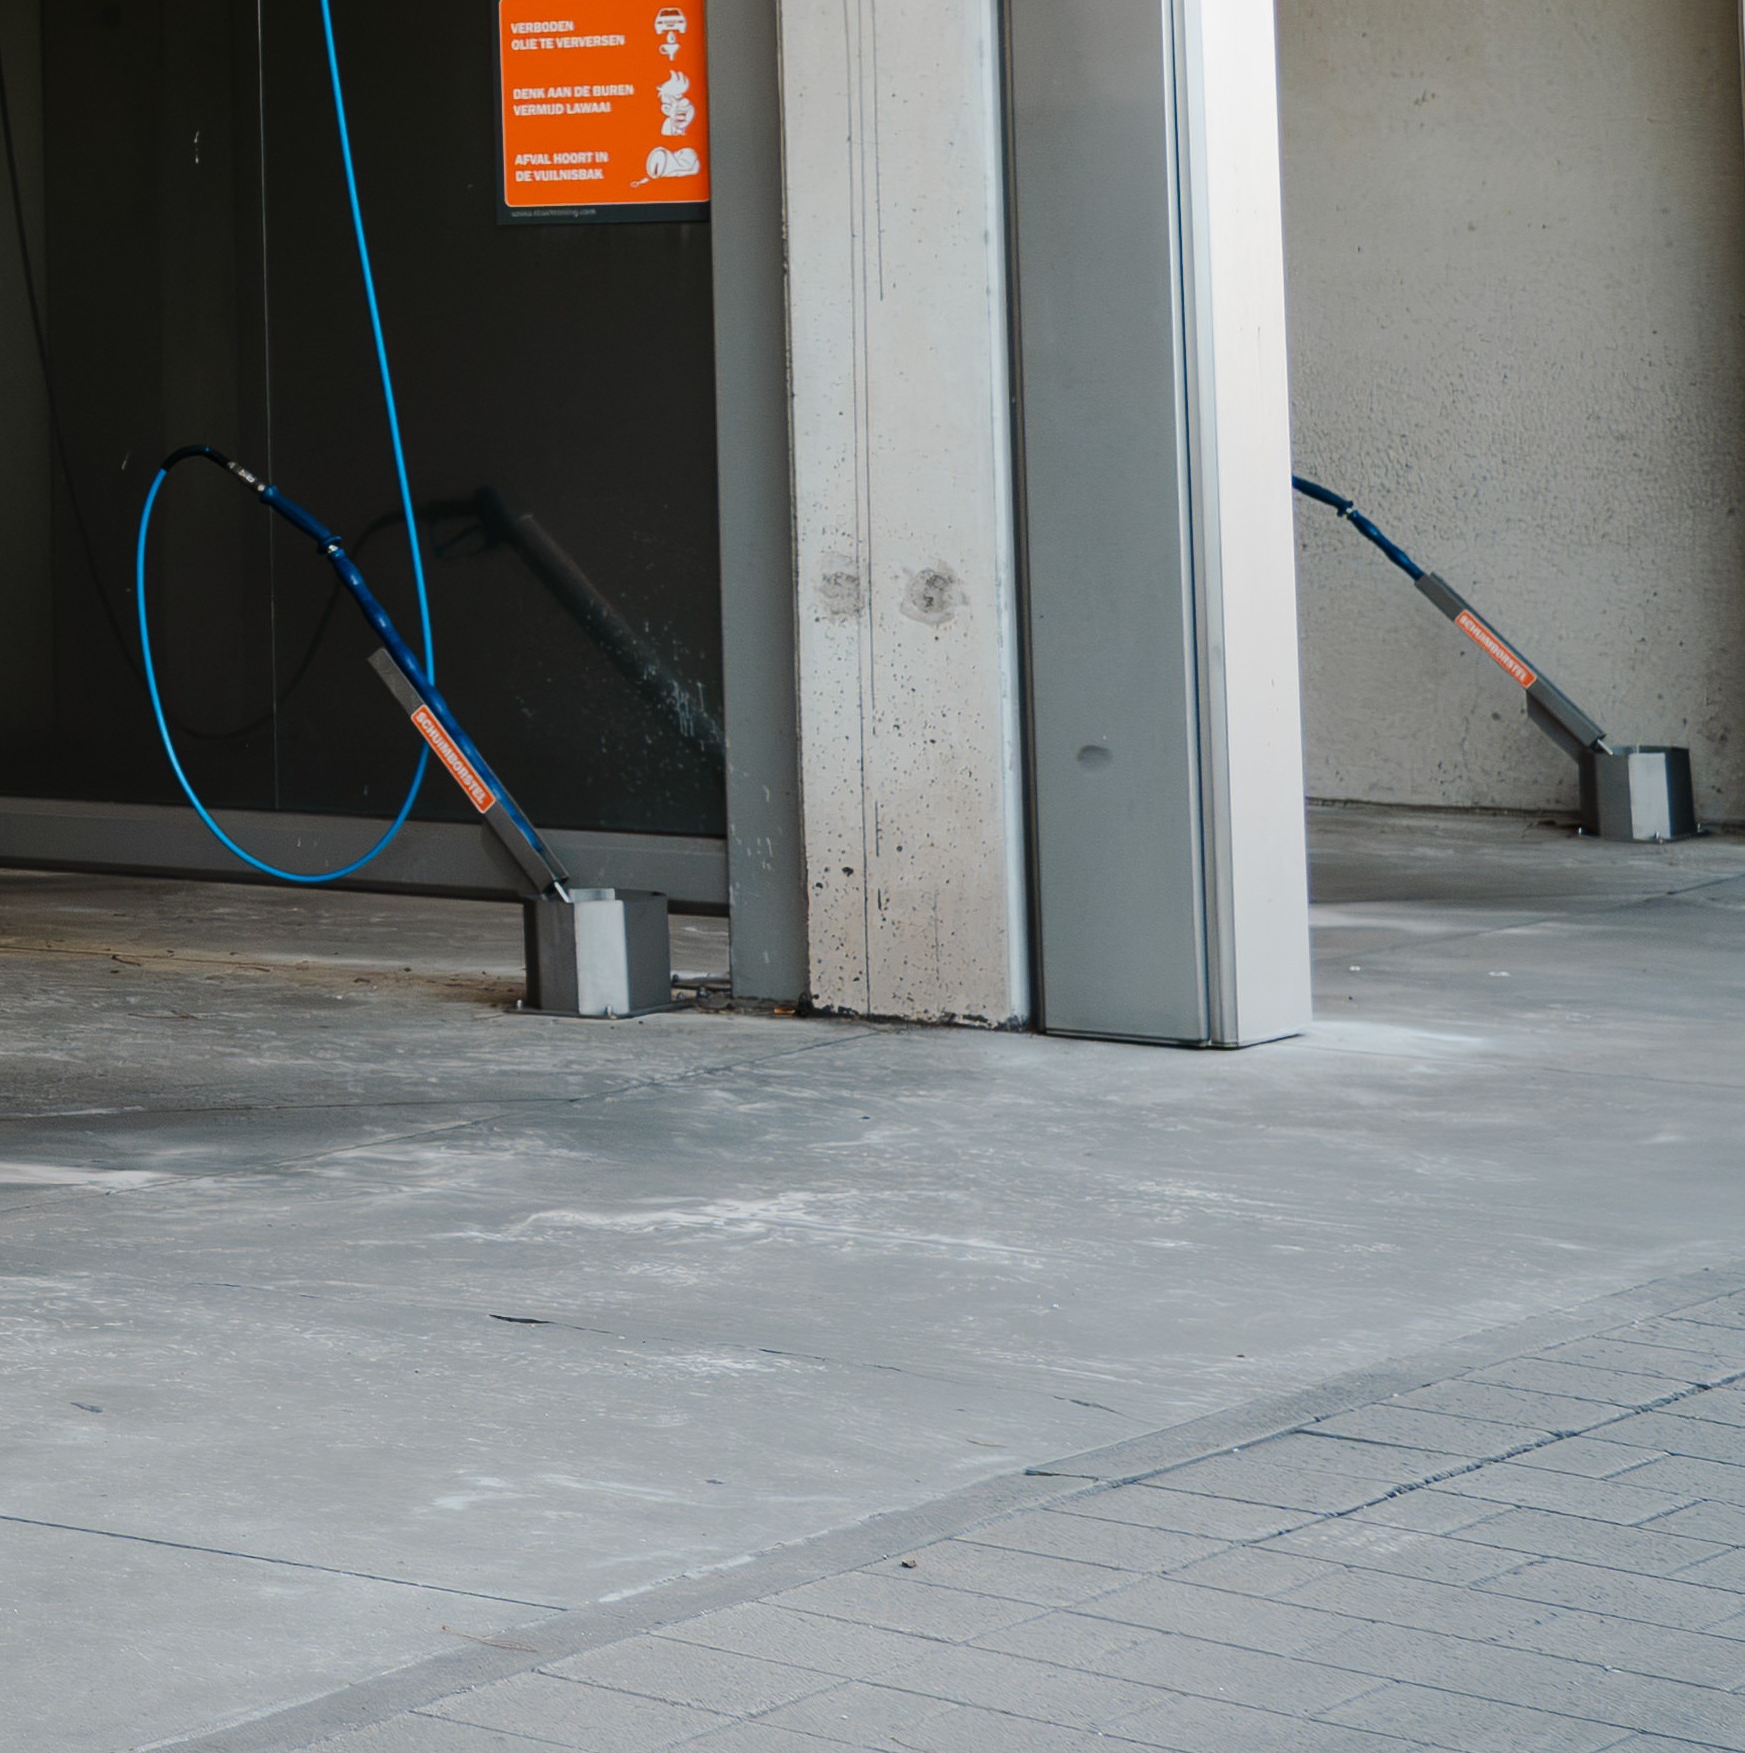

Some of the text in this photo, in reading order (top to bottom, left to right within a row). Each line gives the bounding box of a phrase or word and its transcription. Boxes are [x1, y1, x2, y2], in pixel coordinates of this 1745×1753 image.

[511, 21, 574, 35] VERBODEN
[511, 34, 626, 50] OLIE TE VERVERSEN
[513, 84, 634, 100] DENK AAN DE BUREN
[513, 103, 564, 116] VERMIJD
[515, 152, 608, 166] AFVAL HOORT IN
[515, 168, 604, 182] DE VUILNISBAK
[416, 711, 486, 804] SCHUIMBORSTEL
